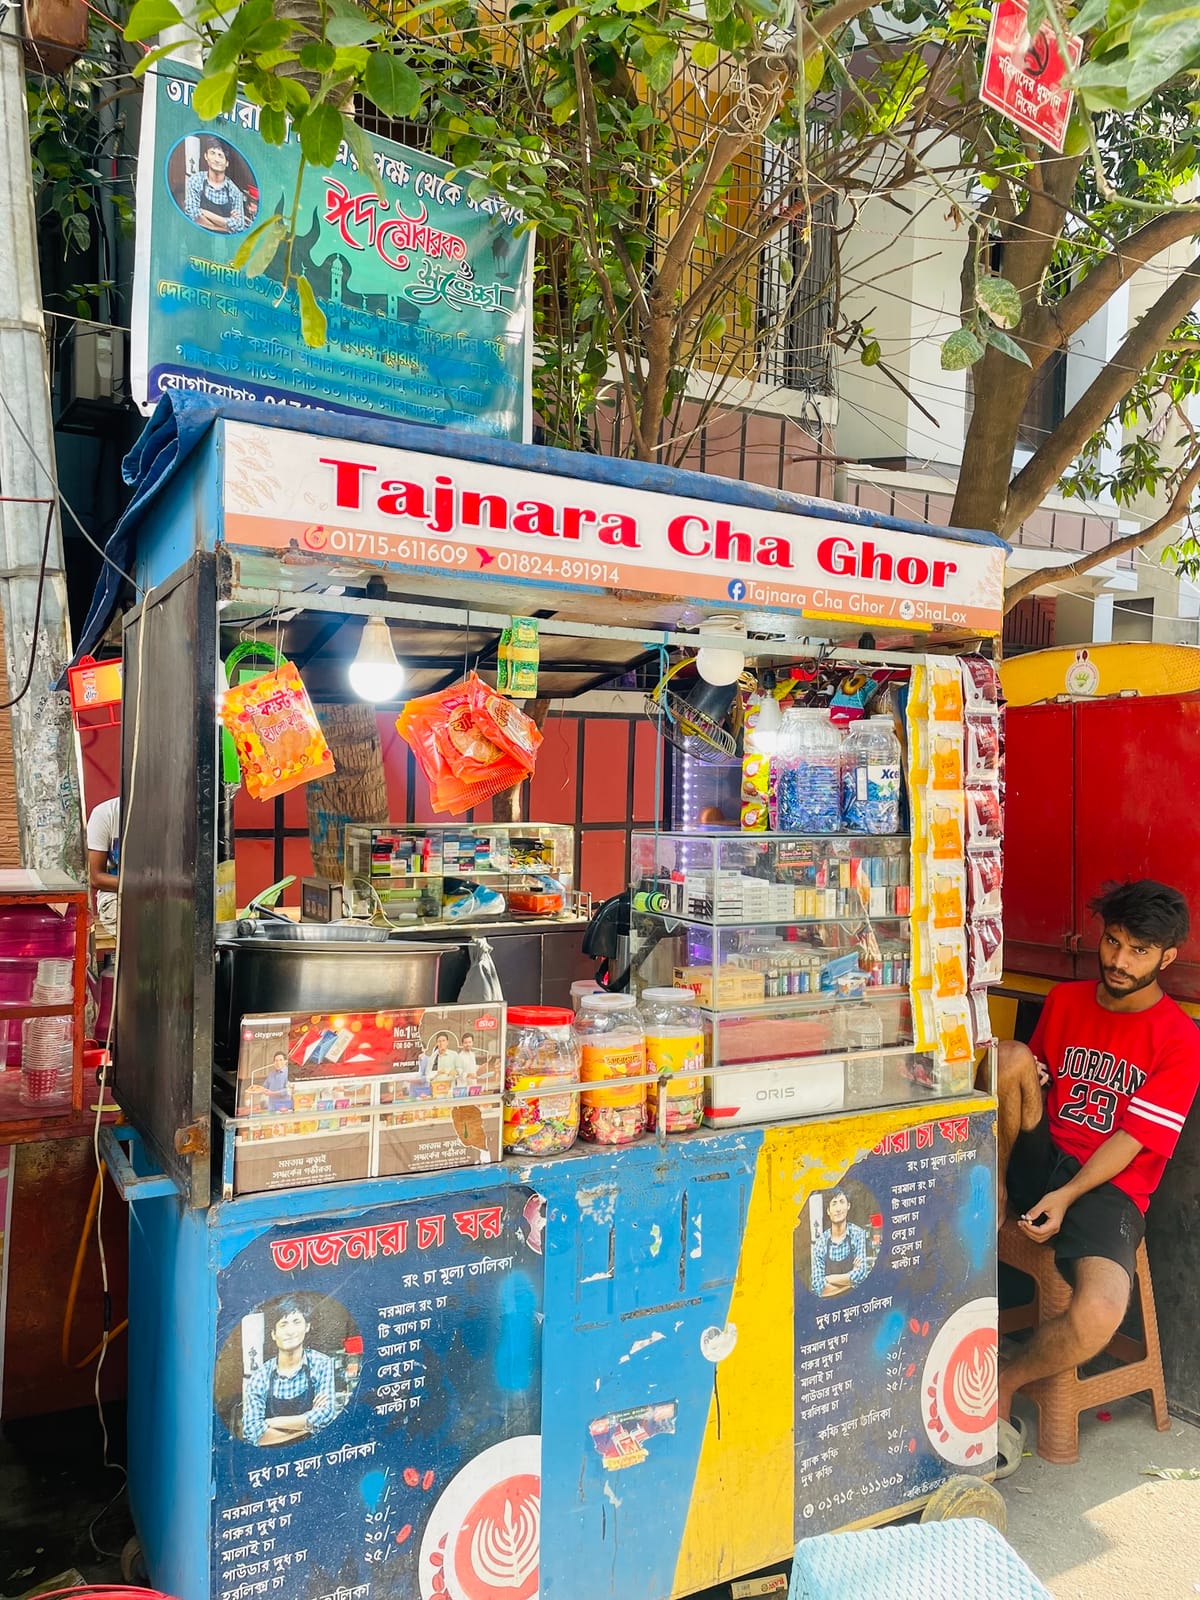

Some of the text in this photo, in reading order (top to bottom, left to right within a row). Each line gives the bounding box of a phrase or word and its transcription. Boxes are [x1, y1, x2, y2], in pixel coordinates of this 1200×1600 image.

[414, 169, 464, 206] থেকে
[376, 198, 468, 271] মোবারক
[157, 280, 213, 310] দোকান
[318, 456, 958, 590] Tajnara Cha Ghor
[329, 531, 468, 566] 01715-611609
[497, 551, 621, 583] 01824-891914
[746, 581, 807, 607] Tajnara
[812, 592, 843, 610] Cha
[848, 593, 884, 614] Ghor
[916, 601, 968, 624] ShaLox
[1057, 1046, 1148, 1097] JORDAN
[756, 1086, 796, 1101] ORIS
[1058, 1082, 1119, 1134] 23
[915, 1116, 969, 1150] চা ঘর
[948, 1149, 977, 1164] তালিকা
[270, 1206, 503, 1273] তাজনারা চা ঘর
[402, 1256, 514, 1288] রং চা মূল্য তালিকা
[378, 1295, 448, 1320] নরমাল রং চা
[816, 1296, 893, 1331] দুধ চা মূল্য তালিকা
[377, 1317, 432, 1340] টি ব্যাগ চা
[377, 1338, 421, 1359] আদা চা
[800, 1332, 849, 1356] নরমাল দুধ চা
[376, 1358, 415, 1380] লেবু চা
[821, 1354, 833, 1368] দুধ
[834, 1350, 843, 1362] চা
[376, 1375, 425, 1399] তেতুল চা
[801, 1369, 833, 1388] মালাই চা
[801, 1378, 852, 1404] পাউডার দুধ চা
[375, 1395, 421, 1418] মাল্টা চা
[831, 1401, 839, 1412] চা
[818, 1407, 892, 1441] কফি মূল্য তালিকা
[248, 1441, 377, 1488] দুধ চা মূল্য তালিকা
[820, 1447, 839, 1462] কফি
[801, 1465, 833, 1488] দুধ কফি
[818, 1472, 904, 1512] ০১৭১৫-৬১১৬০৯
[222, 1490, 303, 1522] নরমাল দুধ চা
[365, 1505, 397, 1525] ২০/-
[222, 1514, 293, 1543] গরুর দুধ চা
[364, 1524, 396, 1544] ২০/-
[221, 1537, 276, 1563] মালাই চা
[221, 1548, 308, 1584] পাউডার দুধ চা
[271, 1575, 286, 1591] চা
